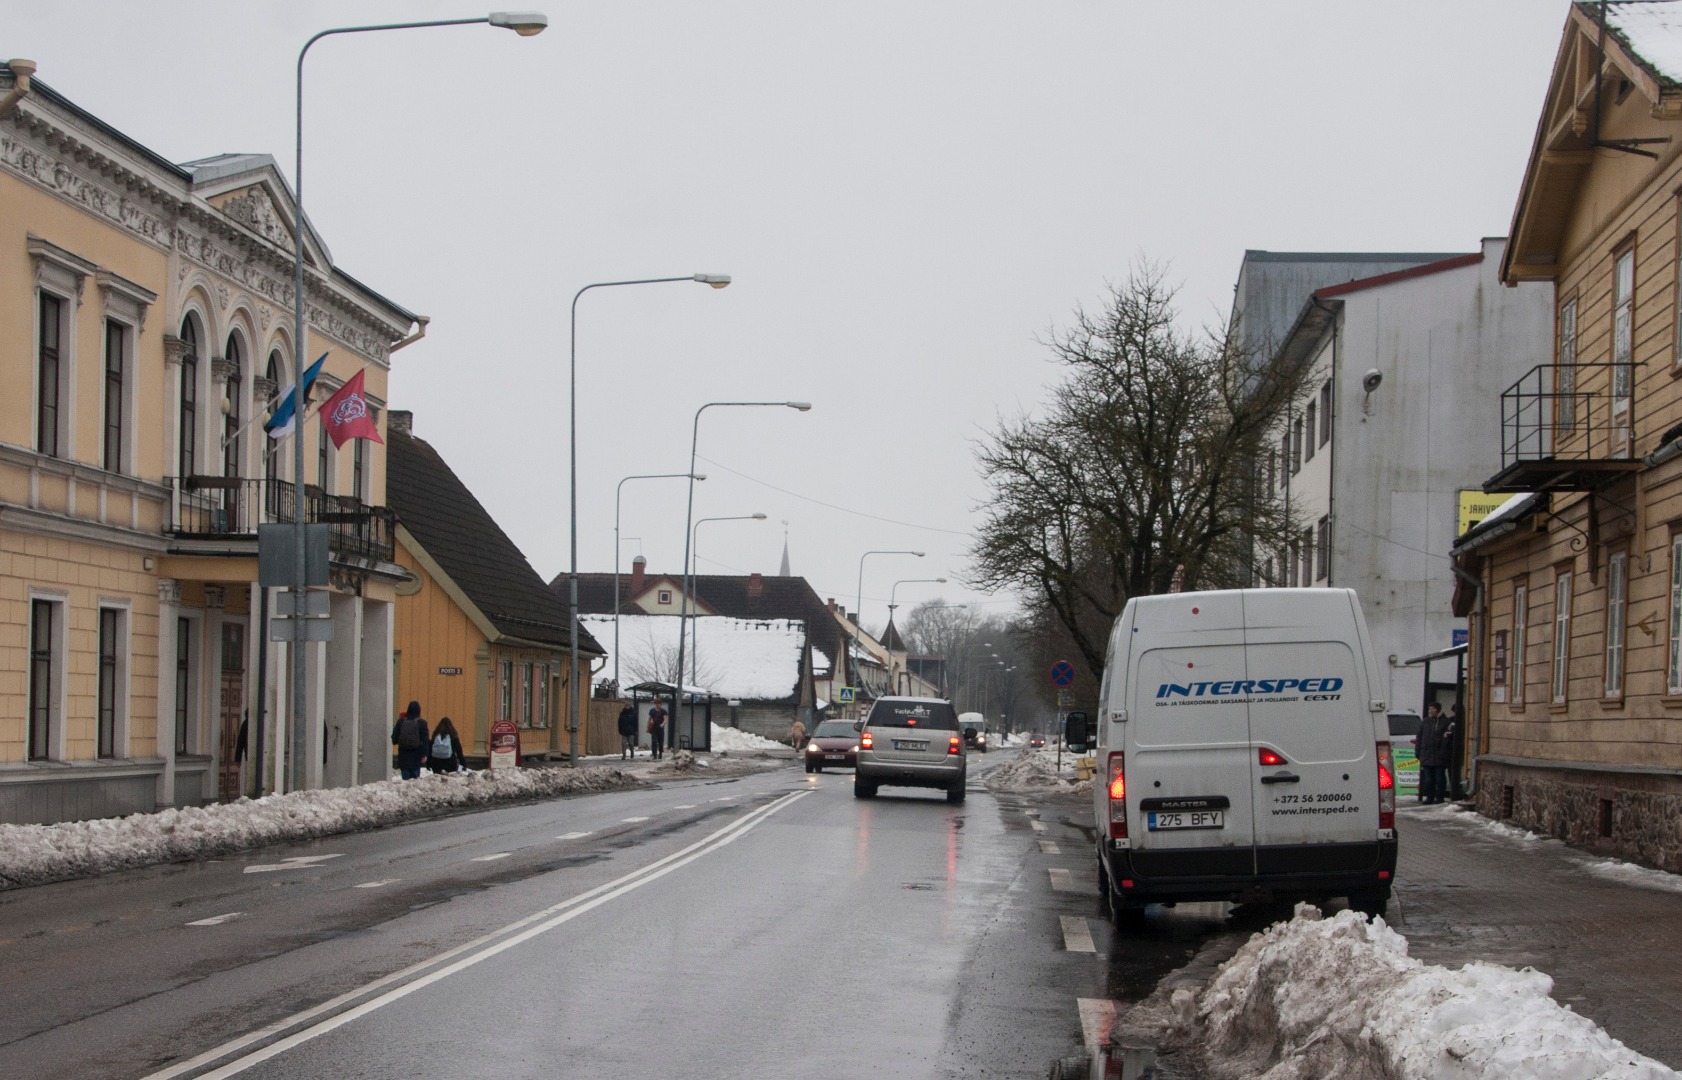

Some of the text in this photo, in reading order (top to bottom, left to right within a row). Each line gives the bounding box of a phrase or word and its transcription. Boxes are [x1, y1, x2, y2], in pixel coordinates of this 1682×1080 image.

[1469, 504, 1500, 514] JAHIVA
[1156, 678, 1343, 698] INTERSPED
[1304, 694, 1341, 702] EESTI
[1273, 793, 1352, 804] +372 56 200060
[1272, 804, 1359, 816] www.intersped.ee
[1160, 812, 1219, 827] 275 BFY
